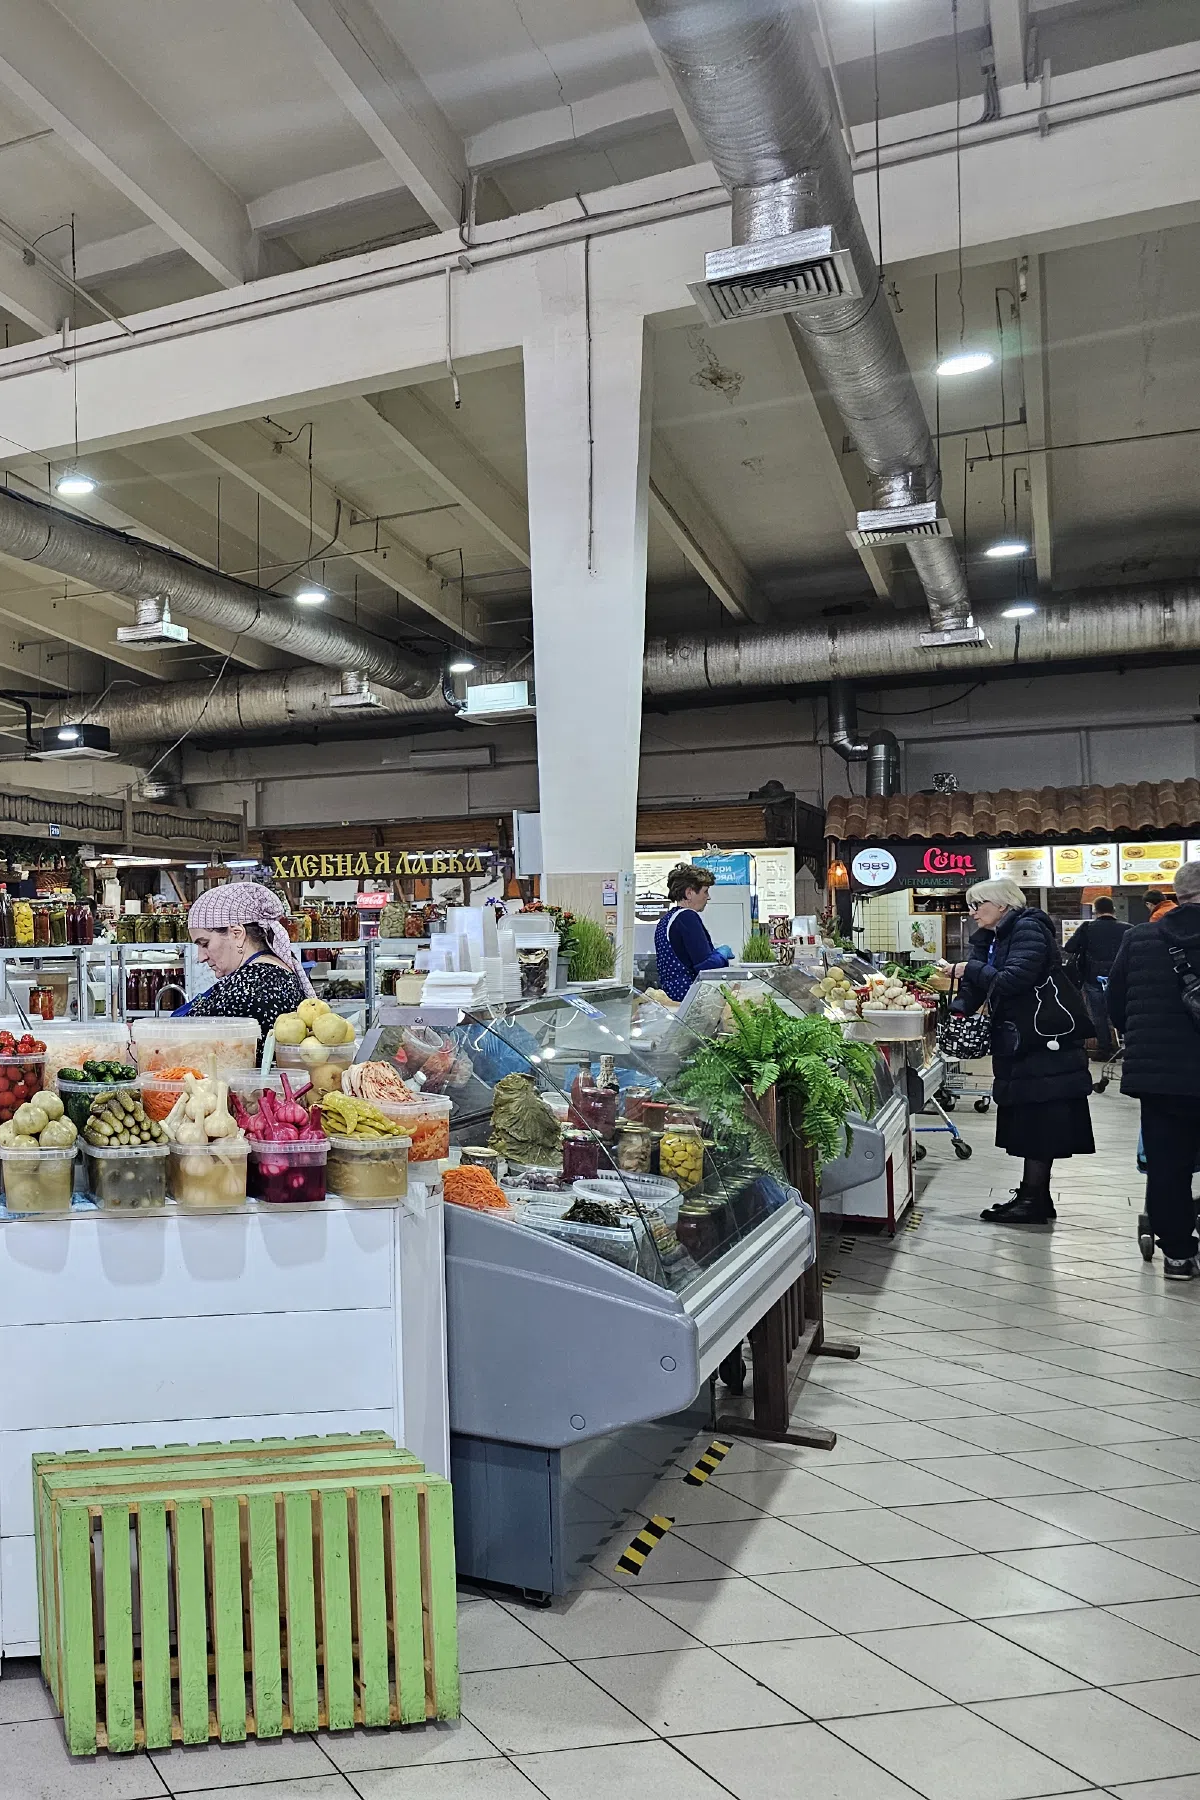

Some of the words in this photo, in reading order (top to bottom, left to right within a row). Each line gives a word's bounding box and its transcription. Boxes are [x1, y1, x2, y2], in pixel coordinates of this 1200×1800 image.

[272, 850, 391, 879] ХЛЕБНАЯ
[395, 848, 485, 875] ЛАВКА
[858, 862, 890, 871] 1989
[898, 878, 954, 886] VIETNAMESE
